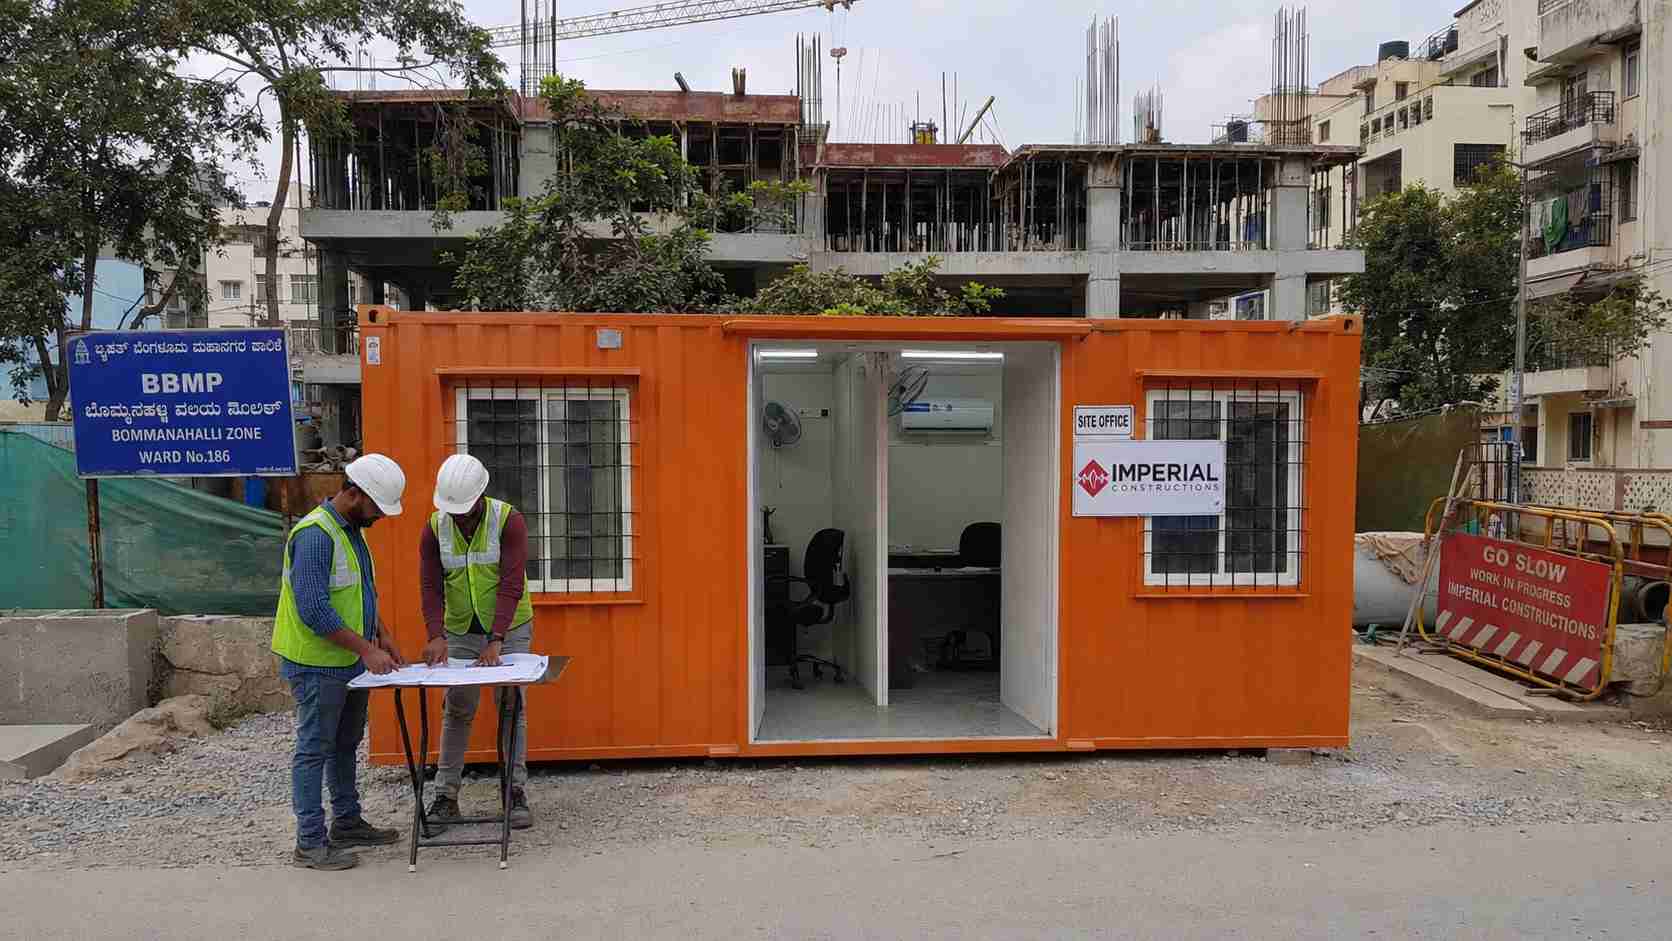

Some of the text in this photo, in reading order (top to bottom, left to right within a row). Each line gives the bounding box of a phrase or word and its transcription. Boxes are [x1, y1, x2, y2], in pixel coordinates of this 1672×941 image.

[141, 372, 223, 394] BBMP
[1078, 414, 1129, 428] SITE OFFICE
[112, 427, 262, 442] BOMMANAHALLI ZONE
[139, 450, 230, 463] WARD No.186
[1112, 463, 1219, 482] IMPERIAL
[1112, 483, 1219, 492] CONSTRUCTIONS
[1483, 545, 1567, 583] GO SLOW
[1470, 567, 1571, 608] WORK IN PROGRESS
[1448, 580, 1596, 640] IMPERIAL CONSTRUCTIONS
